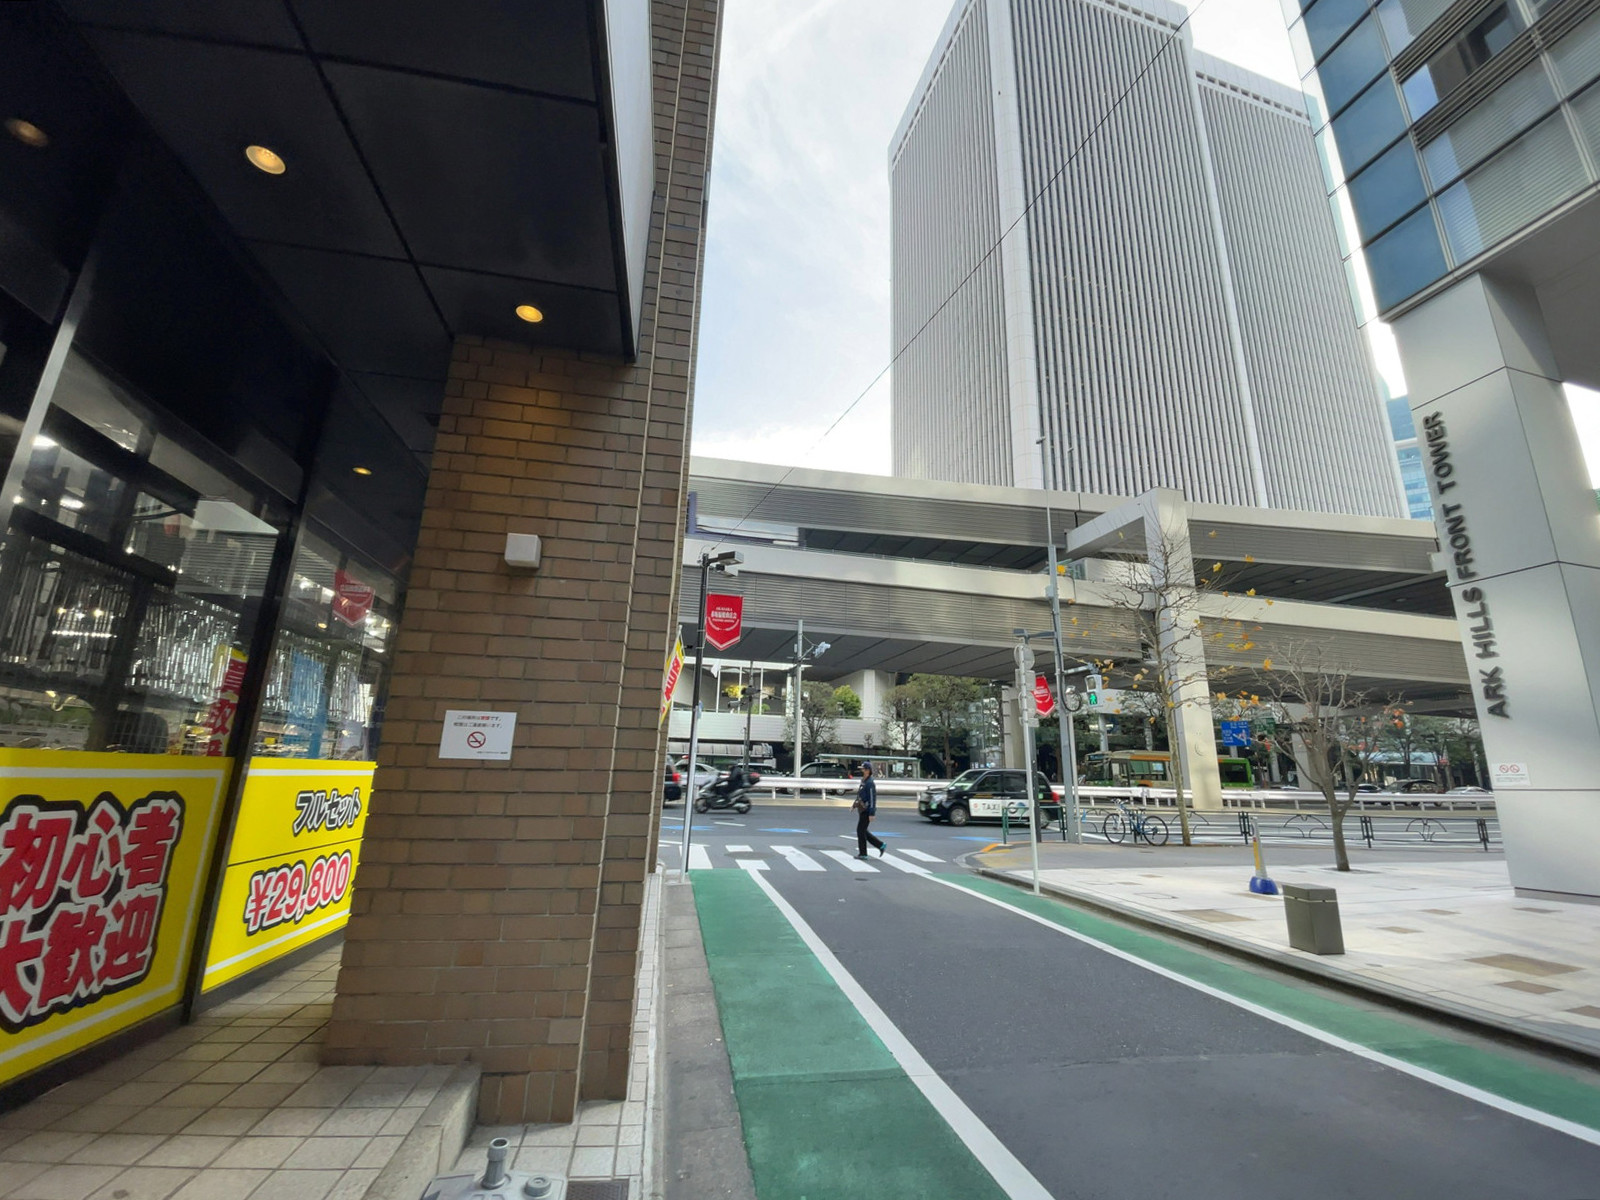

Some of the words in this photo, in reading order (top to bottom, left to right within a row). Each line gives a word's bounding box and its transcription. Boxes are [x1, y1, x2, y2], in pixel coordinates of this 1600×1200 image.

[1423, 410, 1456, 495] TOWER
[1443, 503, 1477, 580] FRONT
[1462, 586, 1498, 660] HILLS
[1480, 665, 1509, 719] ARK
[294, 788, 361, 834] フルセット
[0, 801, 179, 917] 初心者
[245, 852, 351, 932] ¥29,800
[0, 896, 160, 1016] 大歓迎
